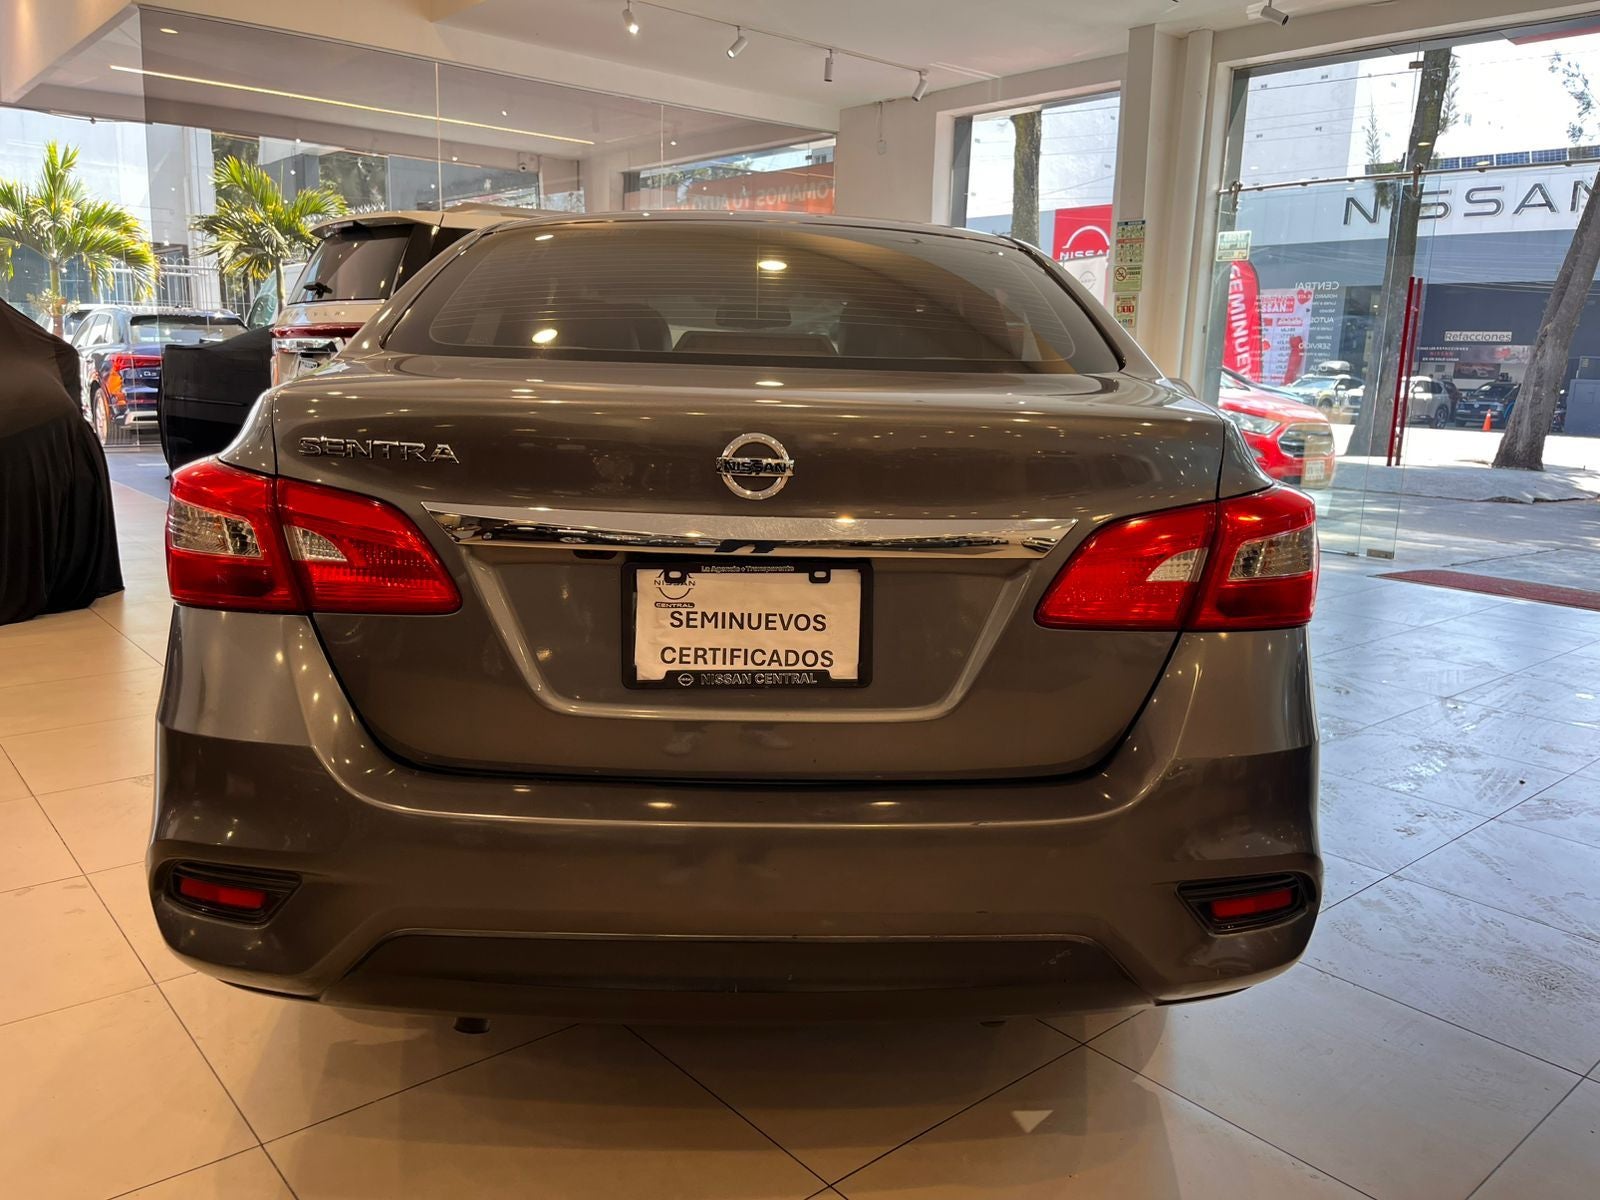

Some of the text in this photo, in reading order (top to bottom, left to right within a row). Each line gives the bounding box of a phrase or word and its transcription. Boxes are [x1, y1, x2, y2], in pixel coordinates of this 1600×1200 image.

[1343, 180, 1592, 225] NSSAN
[1228, 265, 1252, 379] SEMINUEV
[1445, 332, 1512, 341] Refacciones
[299, 436, 460, 464] SENTRA
[723, 461, 787, 473] NISSAN
[747, 565, 795, 573] Transparente
[669, 611, 827, 632] SEMINUEVOS
[660, 646, 834, 668] CERTIFICADOS
[700, 672, 818, 686] NISSAN CENTRAL
